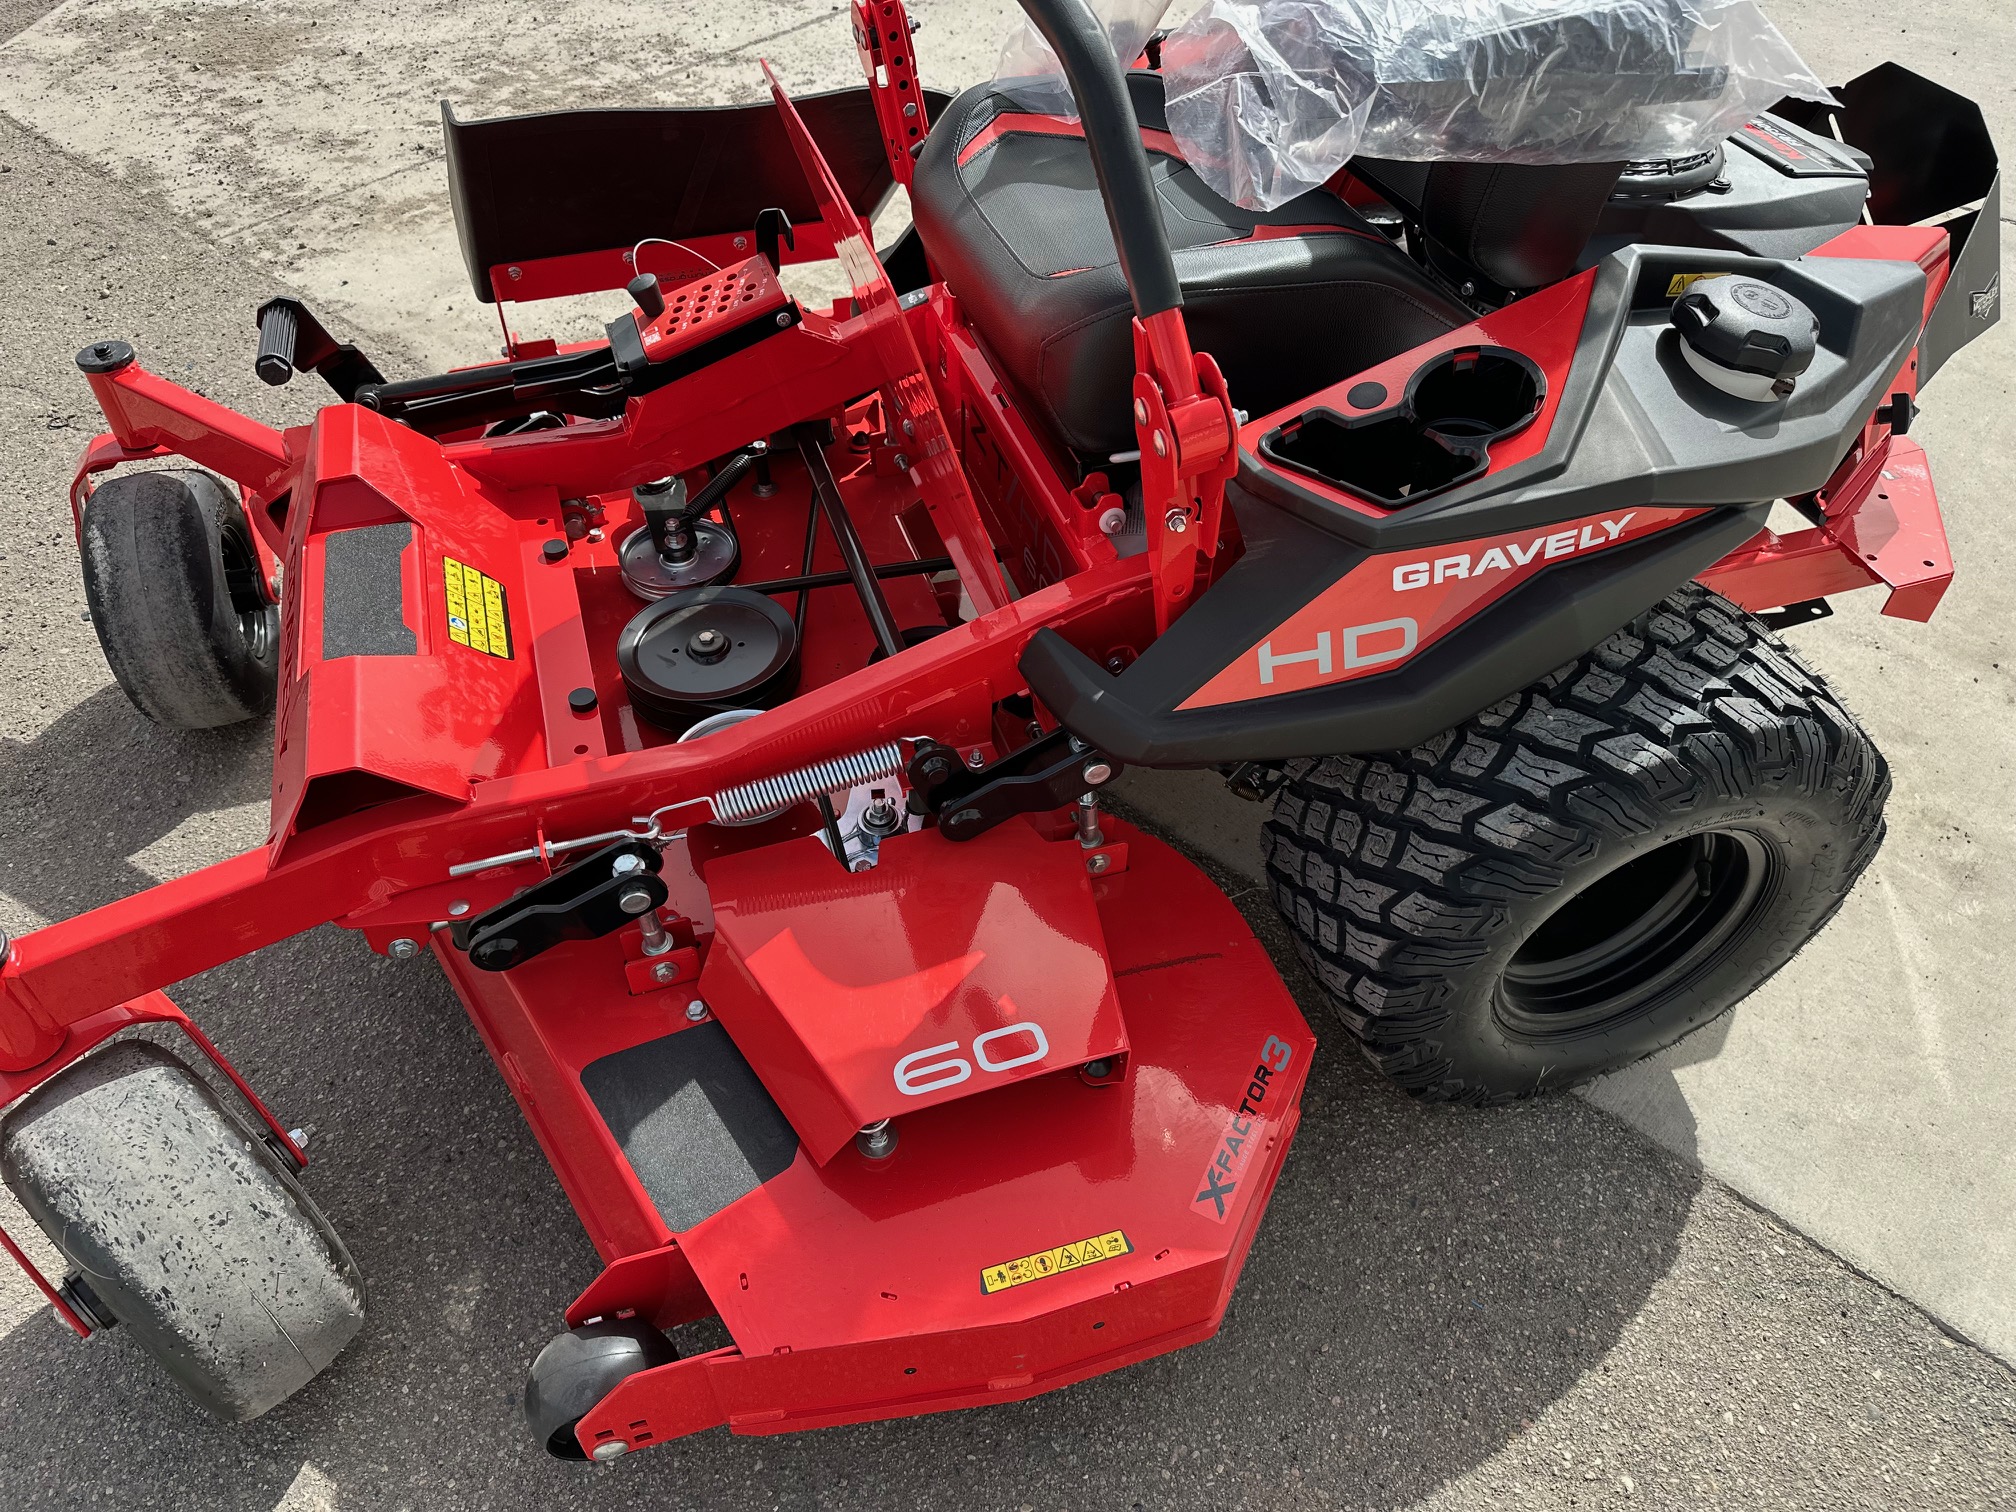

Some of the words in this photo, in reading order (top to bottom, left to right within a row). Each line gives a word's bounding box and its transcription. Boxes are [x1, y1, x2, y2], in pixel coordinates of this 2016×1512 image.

[1393, 512, 1634, 592] GRAVELY
[1257, 617, 1418, 685] HD
[893, 1022, 1049, 1096] 60
